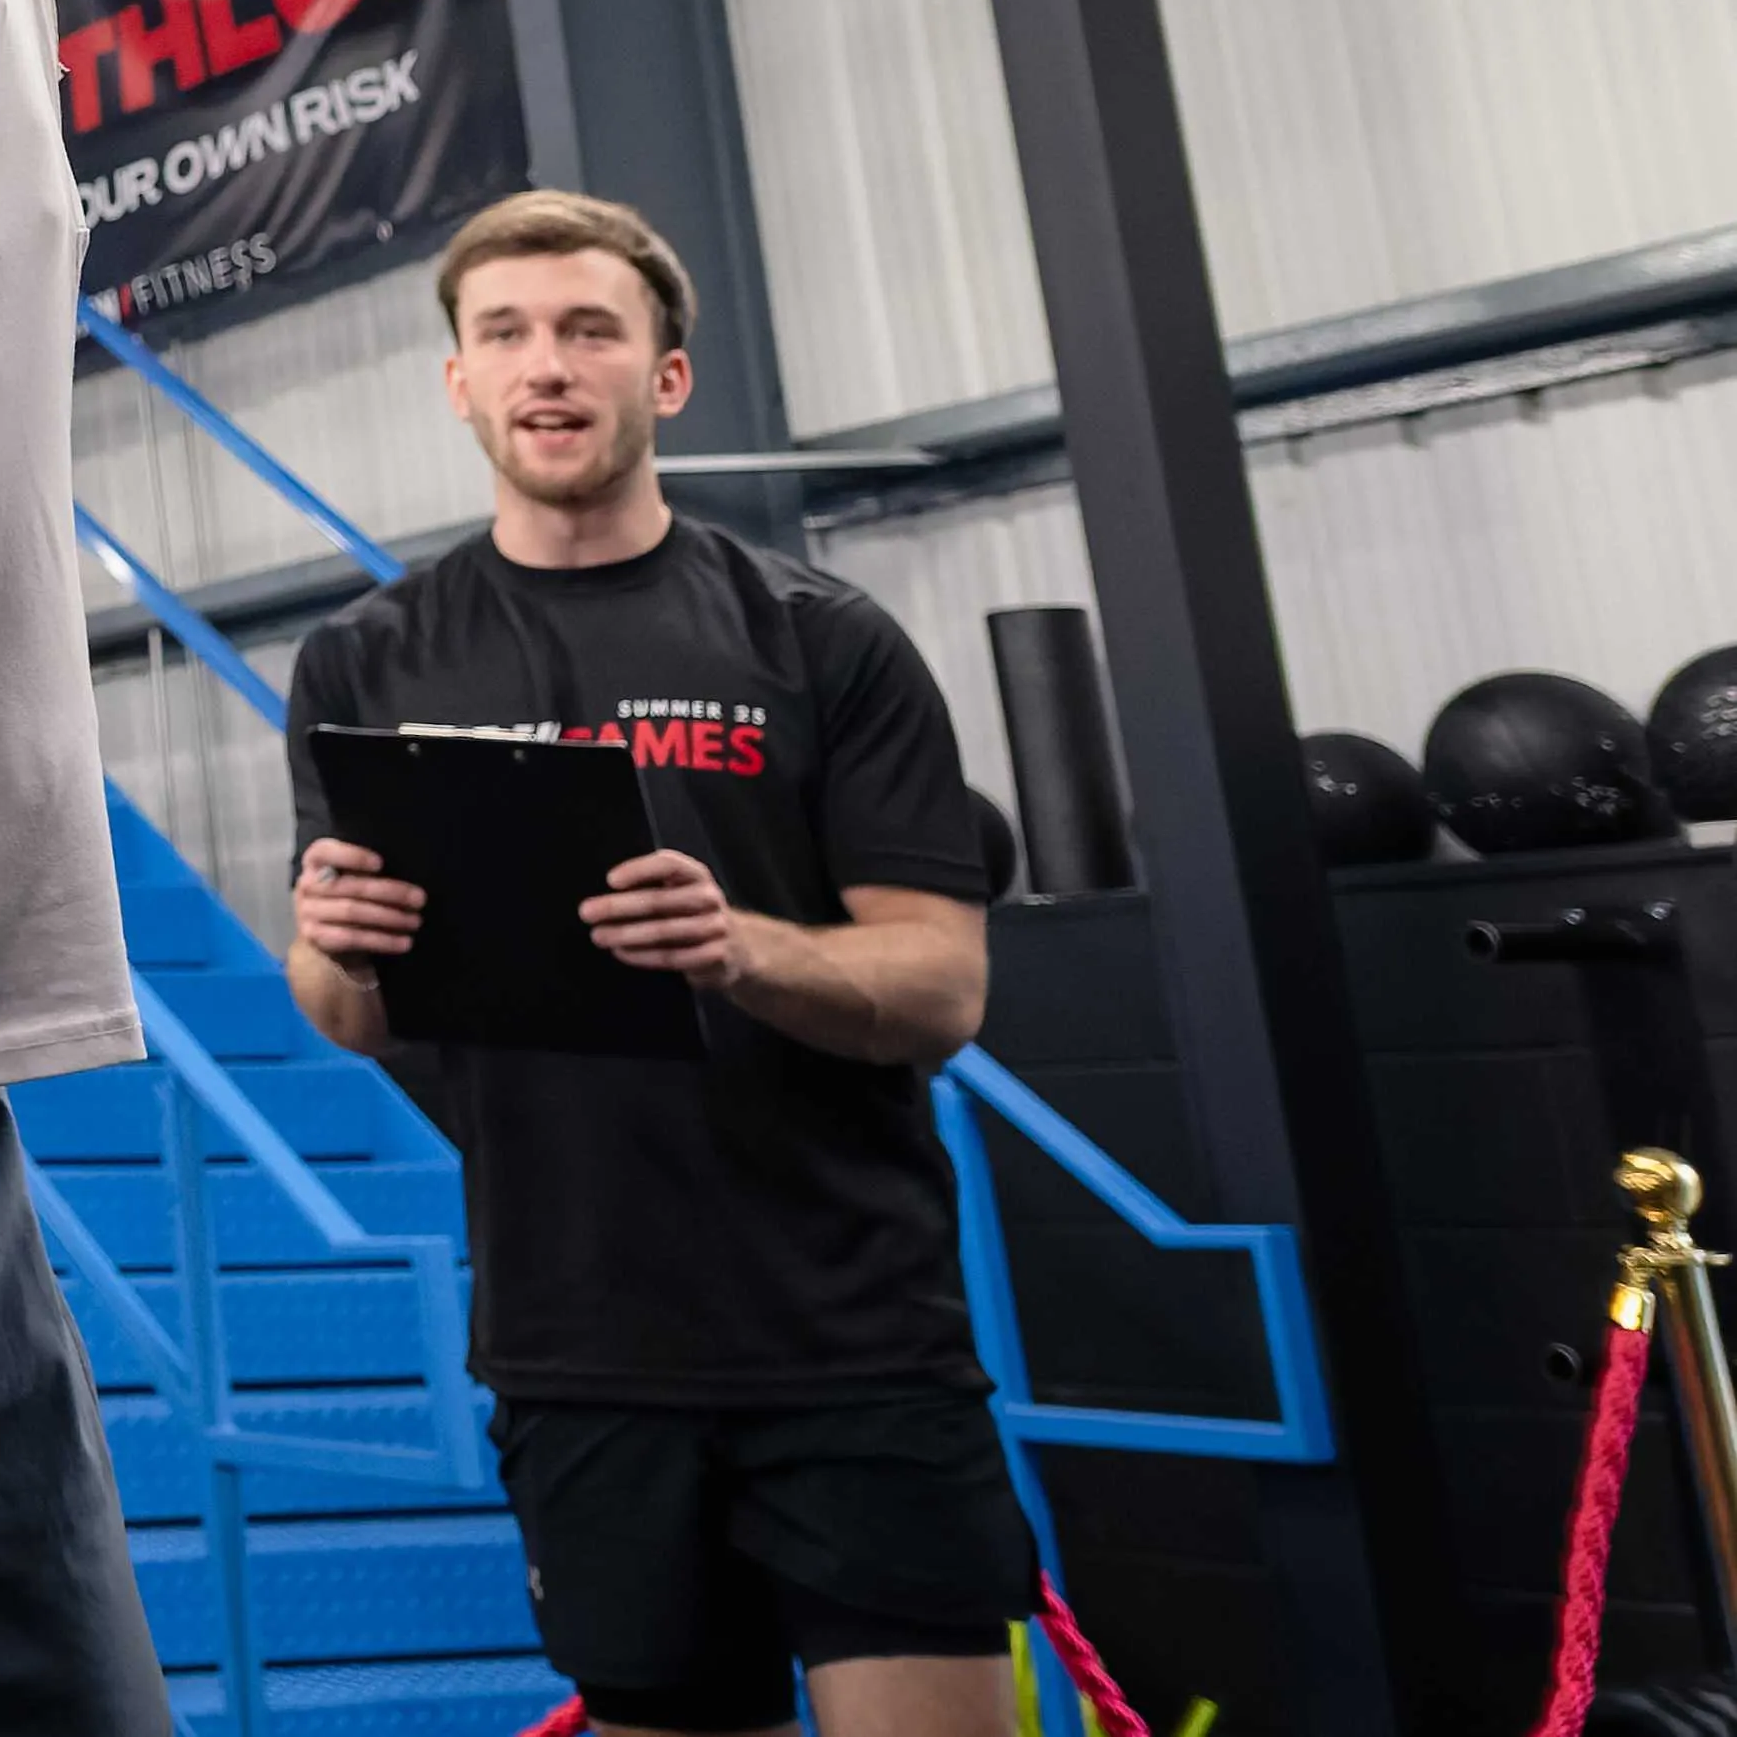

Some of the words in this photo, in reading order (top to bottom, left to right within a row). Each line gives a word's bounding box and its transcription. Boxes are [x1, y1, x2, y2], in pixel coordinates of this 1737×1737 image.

[163, 100, 292, 195] OWN
[289, 48, 421, 145] RISK
[616, 699, 724, 720] SUMMER
